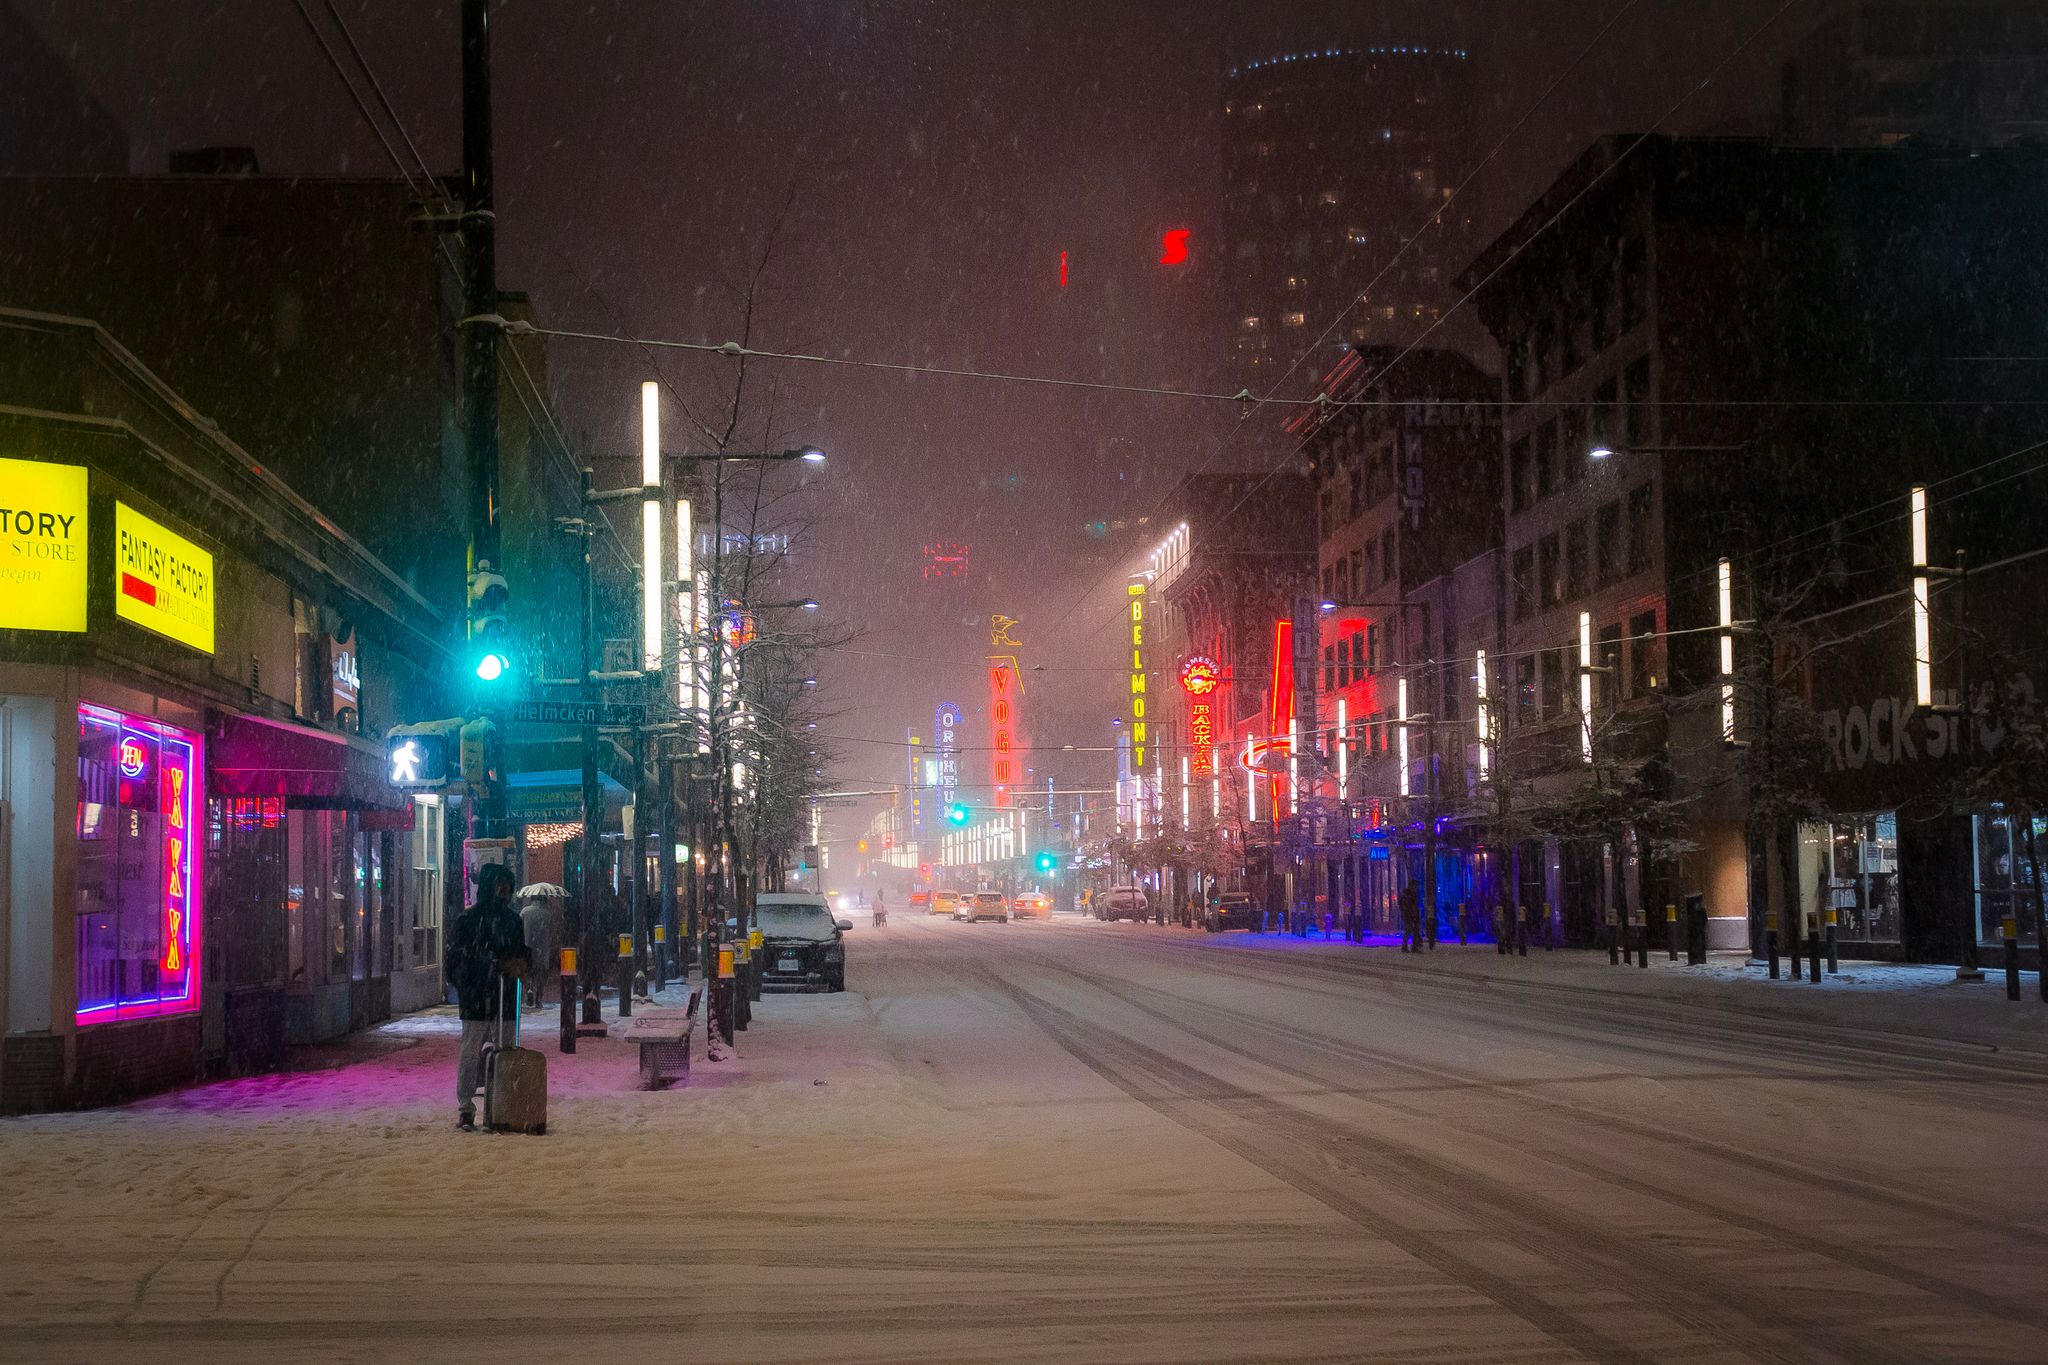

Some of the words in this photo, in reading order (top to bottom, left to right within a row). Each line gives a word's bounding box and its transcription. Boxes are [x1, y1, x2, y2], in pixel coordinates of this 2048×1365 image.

[11, 540, 76, 562] STORE
[121, 530, 167, 582] FANTASY
[170, 556, 209, 604] FACTORY
[1181, 656, 1218, 675] SAMESUN
[1132, 602, 1147, 768] BELMONT
[518, 704, 595, 721] Helmcken
[1822, 696, 1918, 773] ROCK
[1370, 847, 1389, 860] ATM
